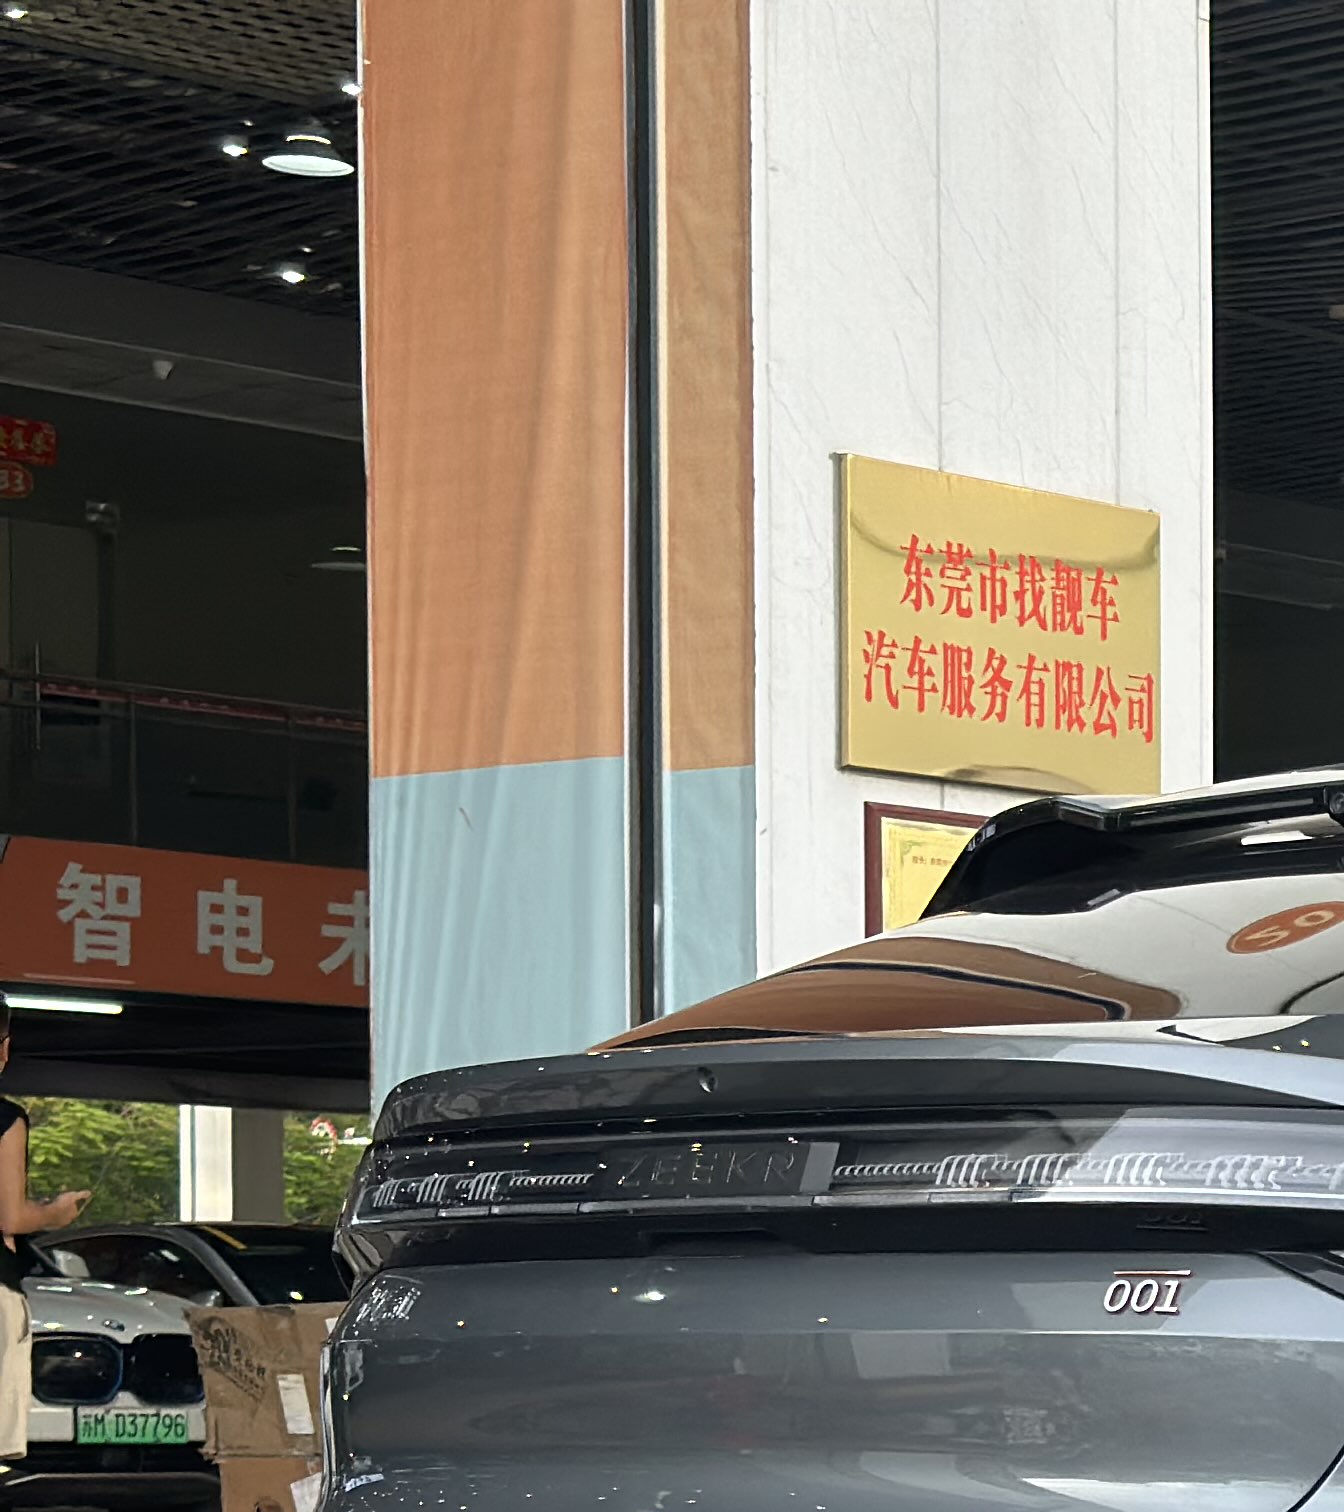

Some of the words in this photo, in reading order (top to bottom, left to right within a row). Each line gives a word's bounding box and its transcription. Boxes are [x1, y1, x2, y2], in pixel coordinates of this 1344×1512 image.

[900, 533, 1120, 641] 东莞市找靓车
[862, 629, 1155, 743] 汽车服务有限公司
[614, 1150, 796, 1186] ZEEKR
[1103, 1279, 1180, 1313] 001
